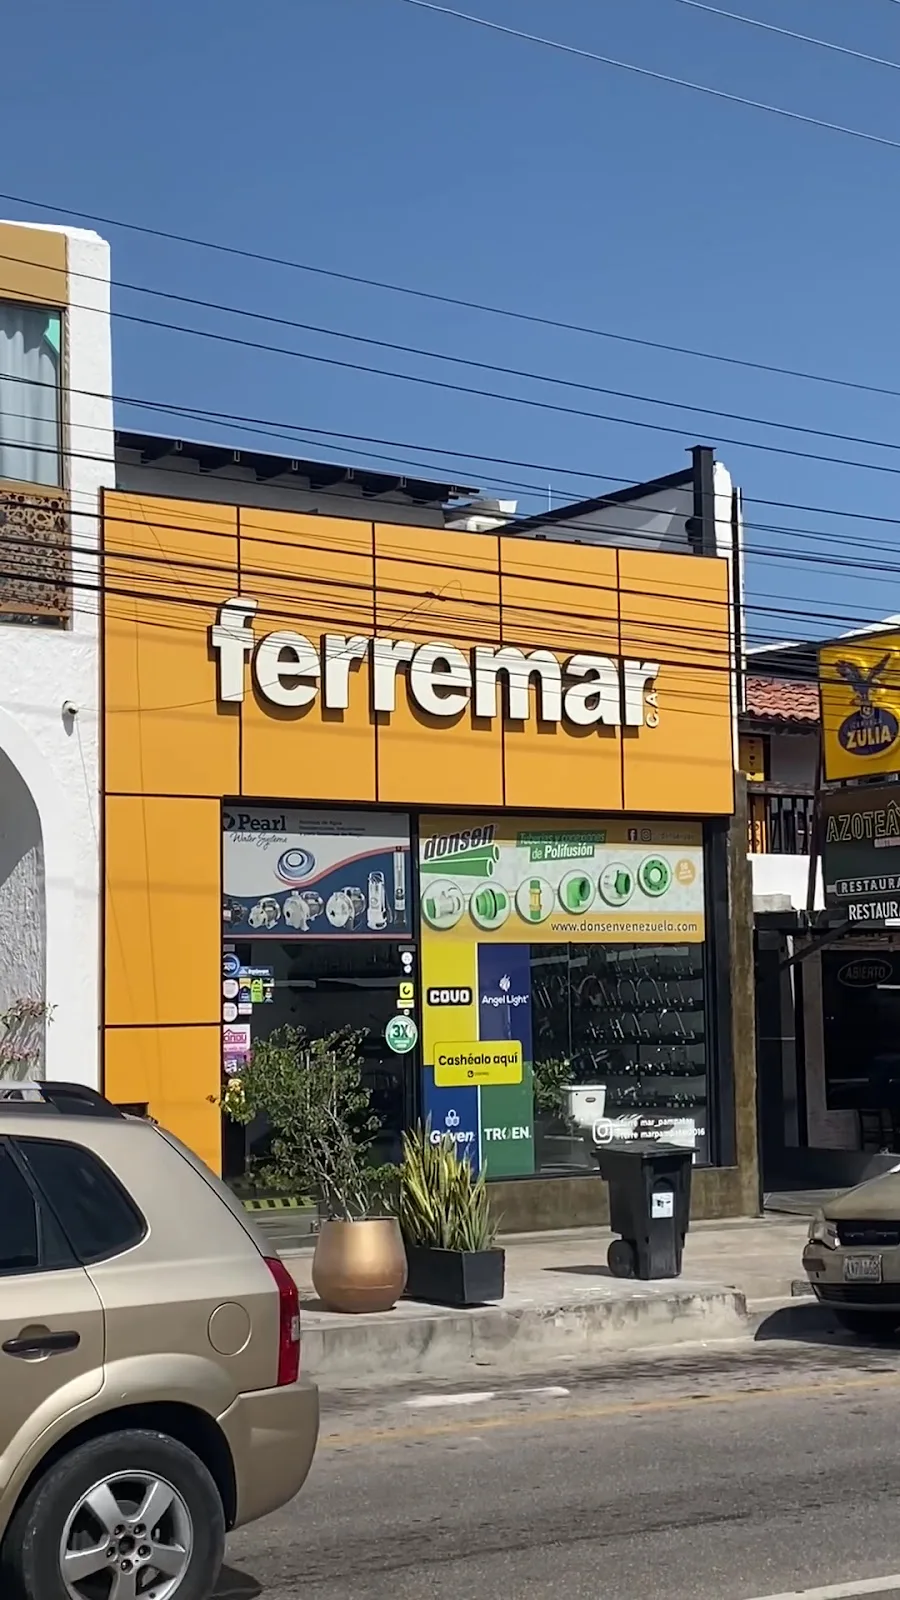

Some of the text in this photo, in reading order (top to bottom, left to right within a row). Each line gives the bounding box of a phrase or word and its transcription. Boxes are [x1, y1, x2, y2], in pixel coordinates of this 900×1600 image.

[209, 597, 660, 728] ferremar
[846, 725, 892, 749] ZULIA
[238, 814, 287, 832] Pearl
[424, 824, 495, 860] donsen
[531, 843, 593, 860] de Polifusión
[848, 902, 900, 920] RESTAUR
[550, 919, 698, 932] www.donsenvenezuela.com
[482, 993, 529, 1007] Angel Light
[438, 1052, 518, 1069] Cashéalo aquí
